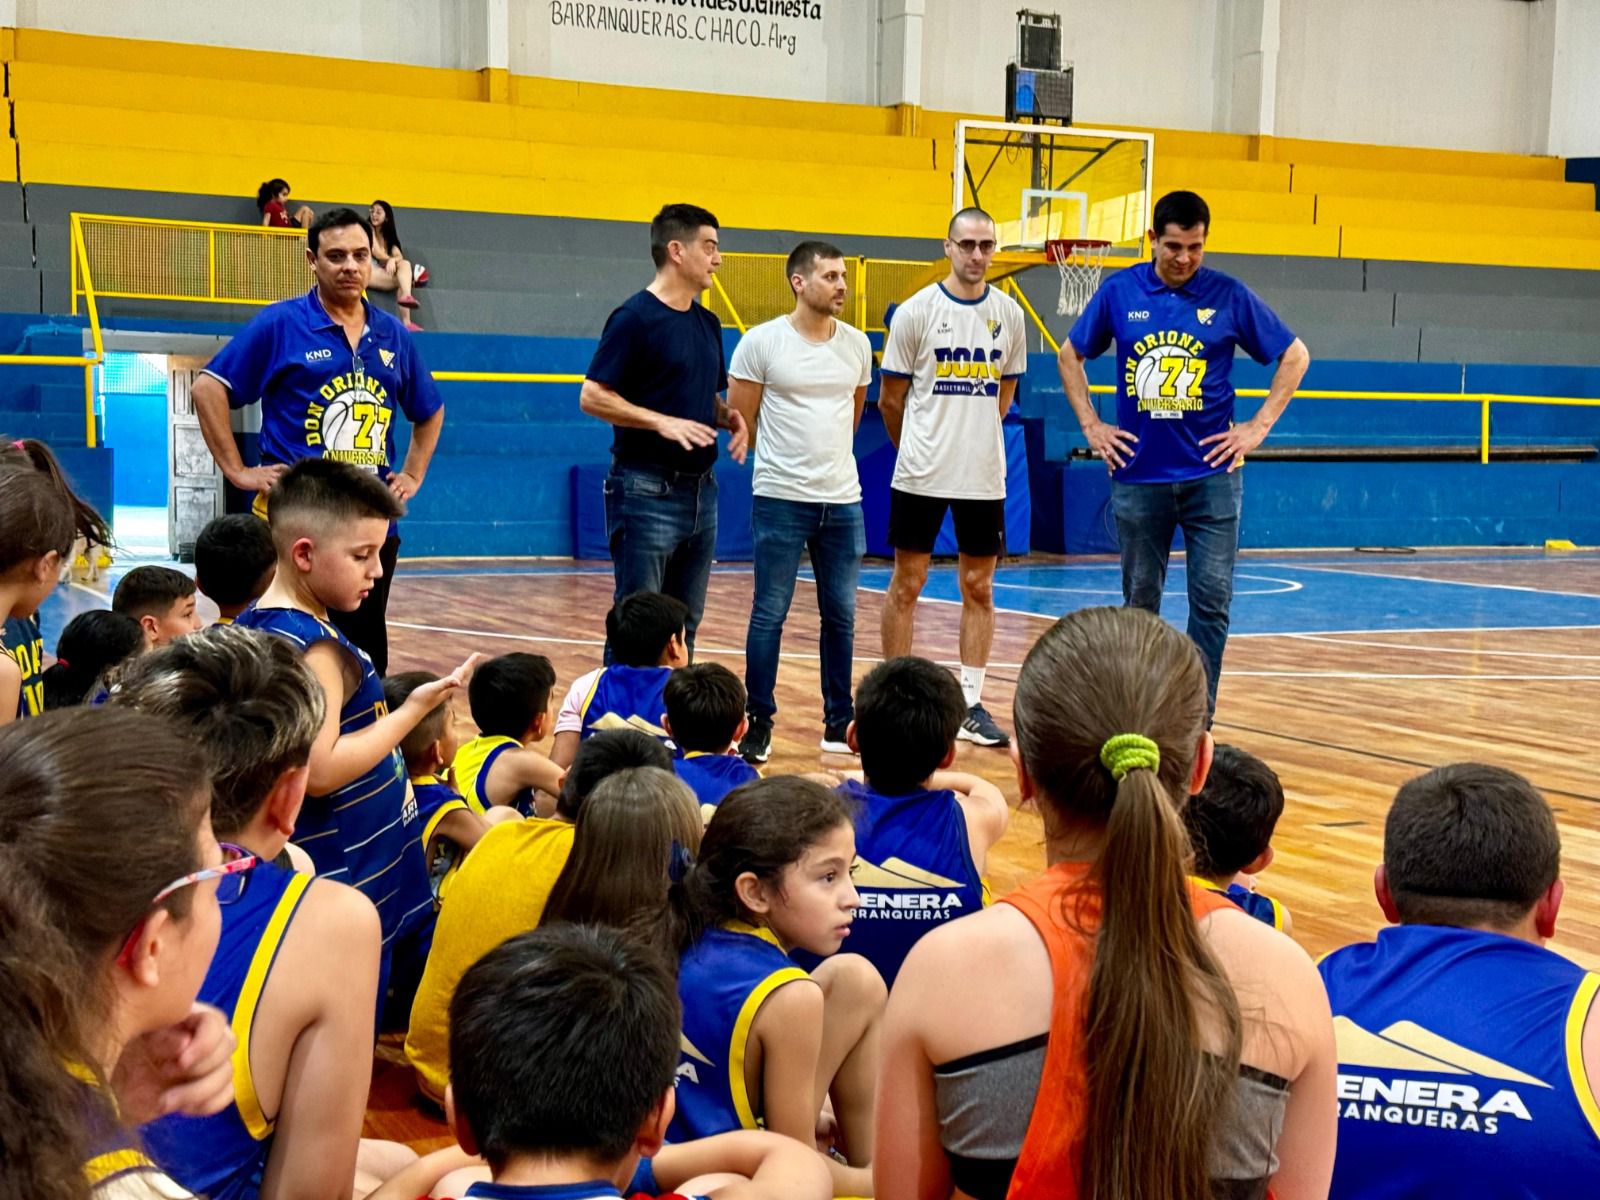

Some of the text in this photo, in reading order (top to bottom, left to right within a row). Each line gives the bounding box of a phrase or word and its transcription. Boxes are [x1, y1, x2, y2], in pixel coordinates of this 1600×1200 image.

[1127, 310, 1150, 321] KND
[305, 348, 332, 361] KND
[1125, 330, 1205, 398] DON ORIONE
[1159, 355, 1208, 397] 77
[304, 401, 325, 447] DON
[352, 401, 393, 451] 77
[849, 908, 951, 921] RRANQUERAS
[859, 892, 963, 910] ENERA
[1337, 1073, 1533, 1121] ENERA
[1337, 1102, 1499, 1135] ANQUERAS
